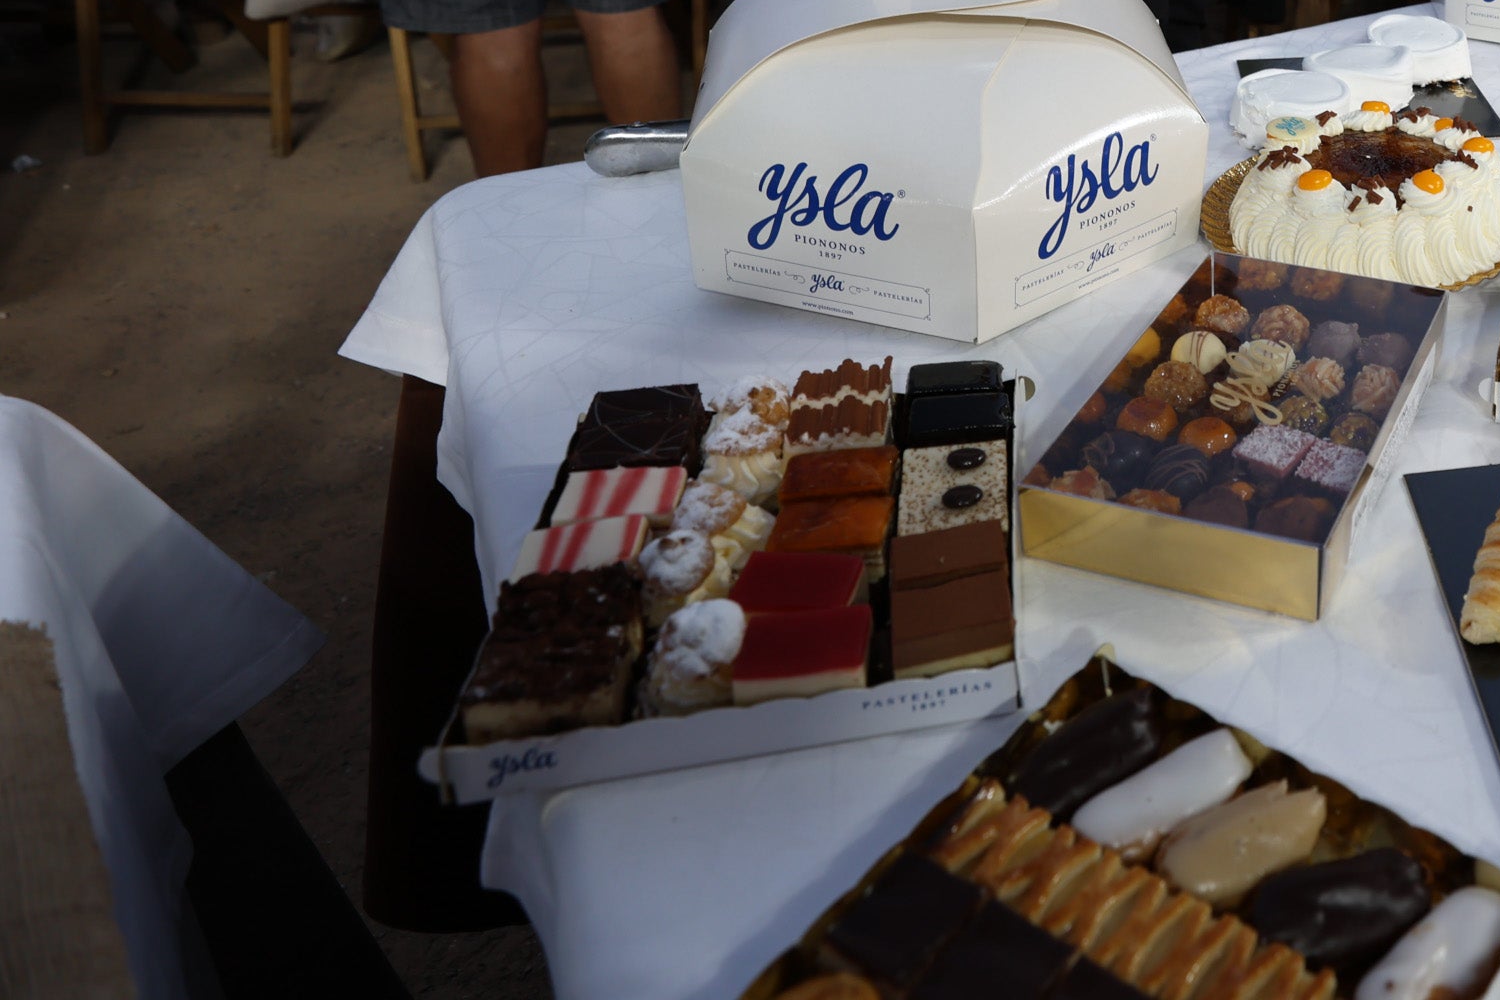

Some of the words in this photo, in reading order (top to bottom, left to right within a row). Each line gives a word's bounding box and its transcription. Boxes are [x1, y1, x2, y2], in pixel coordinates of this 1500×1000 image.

[1079, 200, 1137, 230] PIONONOS
[1099, 218, 1119, 232] 1897
[794, 233, 867, 256] PIONONOS
[819, 251, 843, 261] 1897
[733, 262, 782, 277] PASTELERÍAS
[873, 289, 924, 305] PASTELERÍAS
[862, 683, 993, 710] PASTELERÍAS
